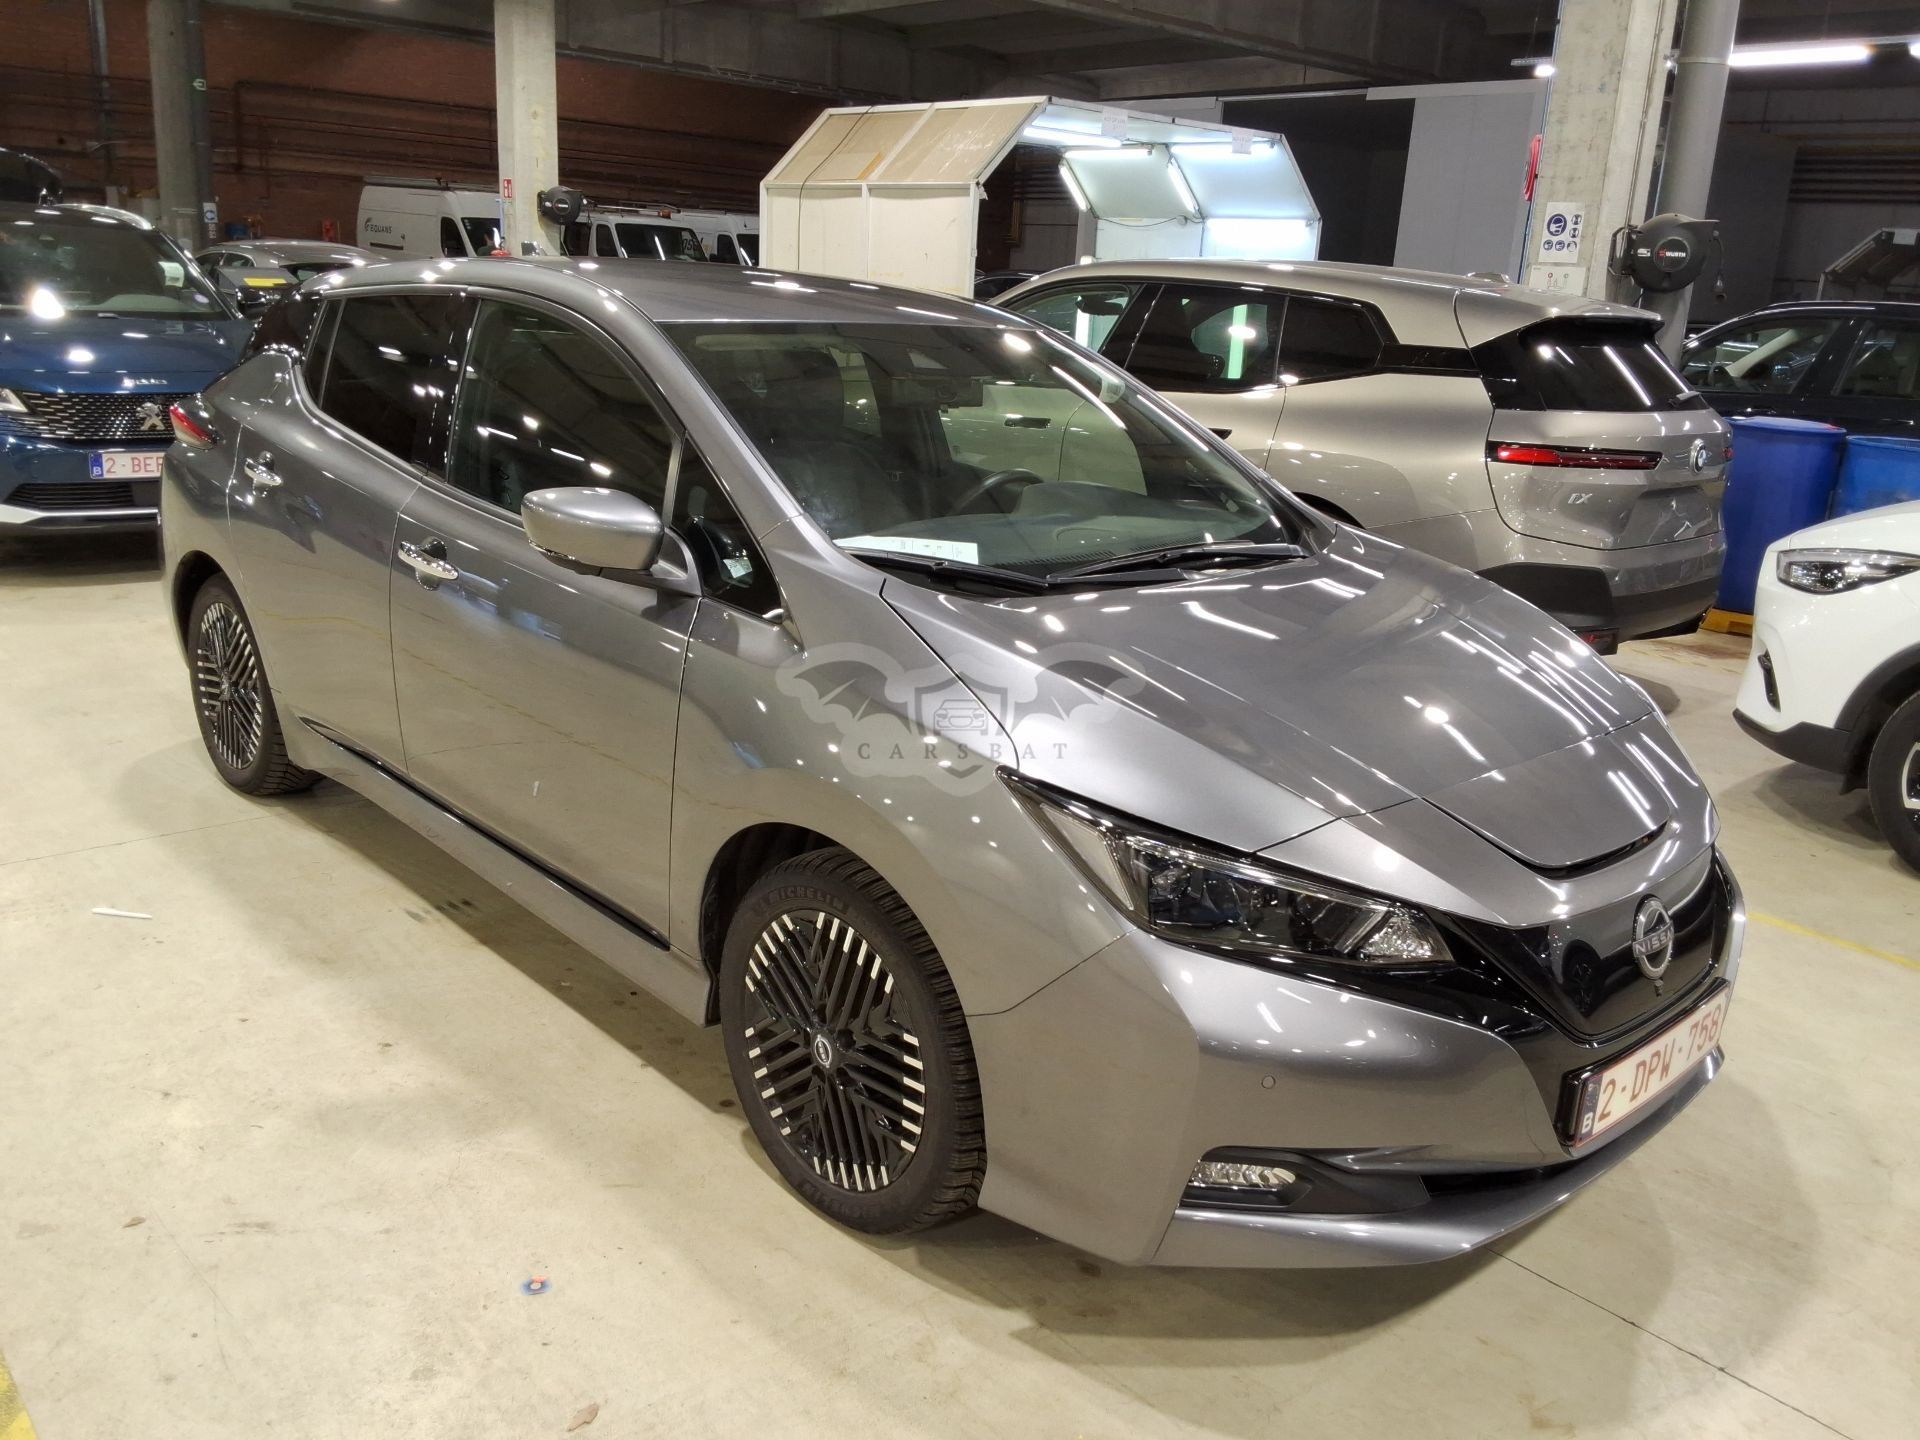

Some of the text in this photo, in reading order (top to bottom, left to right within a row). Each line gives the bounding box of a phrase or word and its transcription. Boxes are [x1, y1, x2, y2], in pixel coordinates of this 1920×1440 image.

[93, 466, 102, 475] B
[769, 886, 844, 911] MICHELIN
[1598, 1004, 1722, 1123] 2-DPW-758
[1581, 1111, 1594, 1134] B
